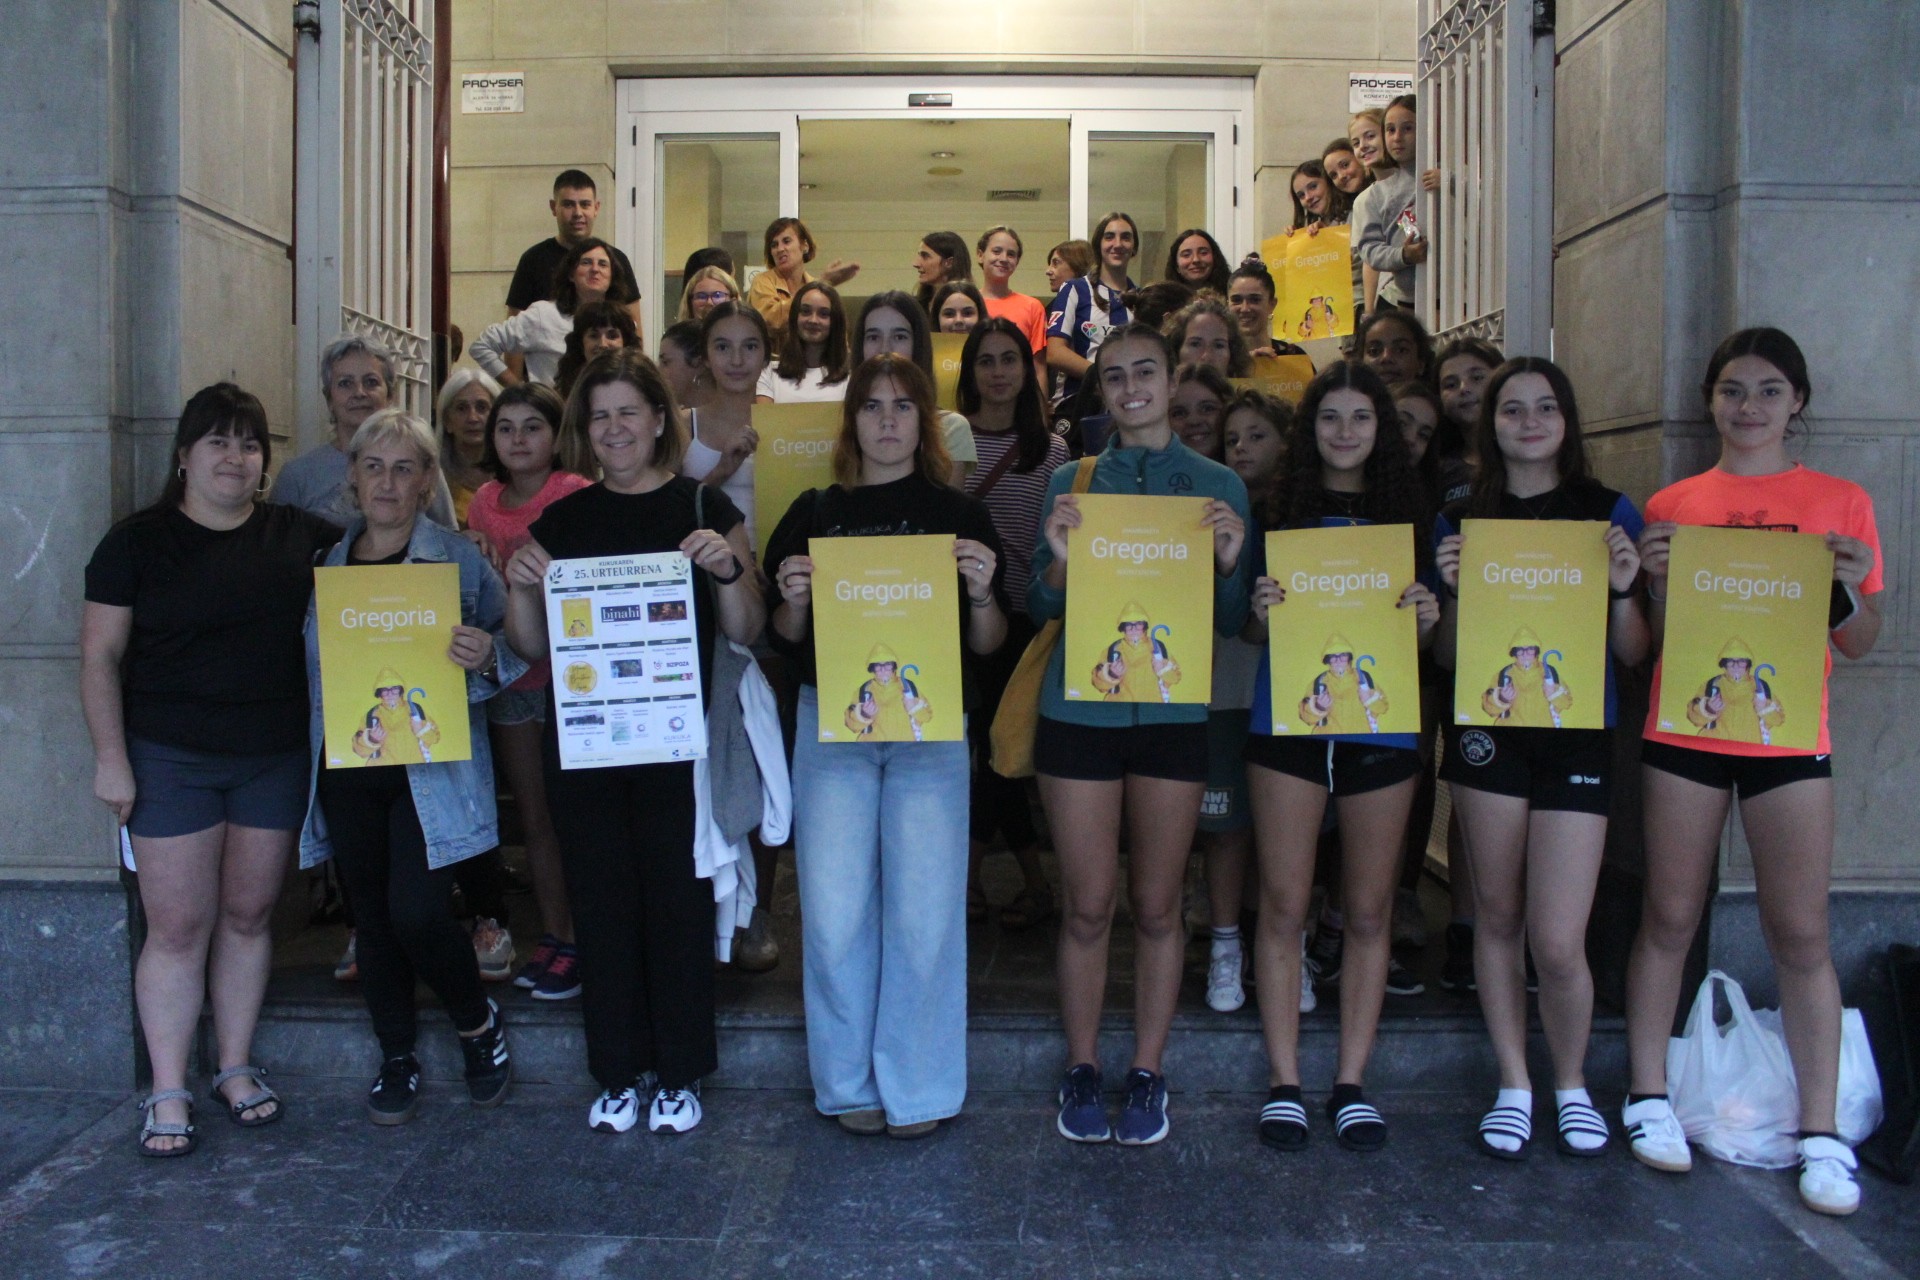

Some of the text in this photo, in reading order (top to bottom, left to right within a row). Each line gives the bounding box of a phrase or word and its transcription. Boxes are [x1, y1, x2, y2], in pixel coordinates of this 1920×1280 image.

[462, 79, 524, 89] PROYSER
[1350, 79, 1413, 89] PROYSER
[1295, 251, 1339, 267] Gregoria
[772, 437, 836, 458] Gregor
[848, 525, 892, 536] KUKUKA
[1091, 537, 1188, 564] Gregoria
[574, 564, 662, 580] 25. URTEURRENA
[1484, 562, 1582, 589] Gregoria
[1291, 567, 1389, 596] Gregoria
[1694, 569, 1802, 600] Gregoria
[835, 577, 932, 605] Gregoria
[341, 605, 436, 632] Gregoria
[602, 606, 640, 620] binahi
[1203, 791, 1230, 803] AWL
[1200, 803, 1228, 815] ARS
